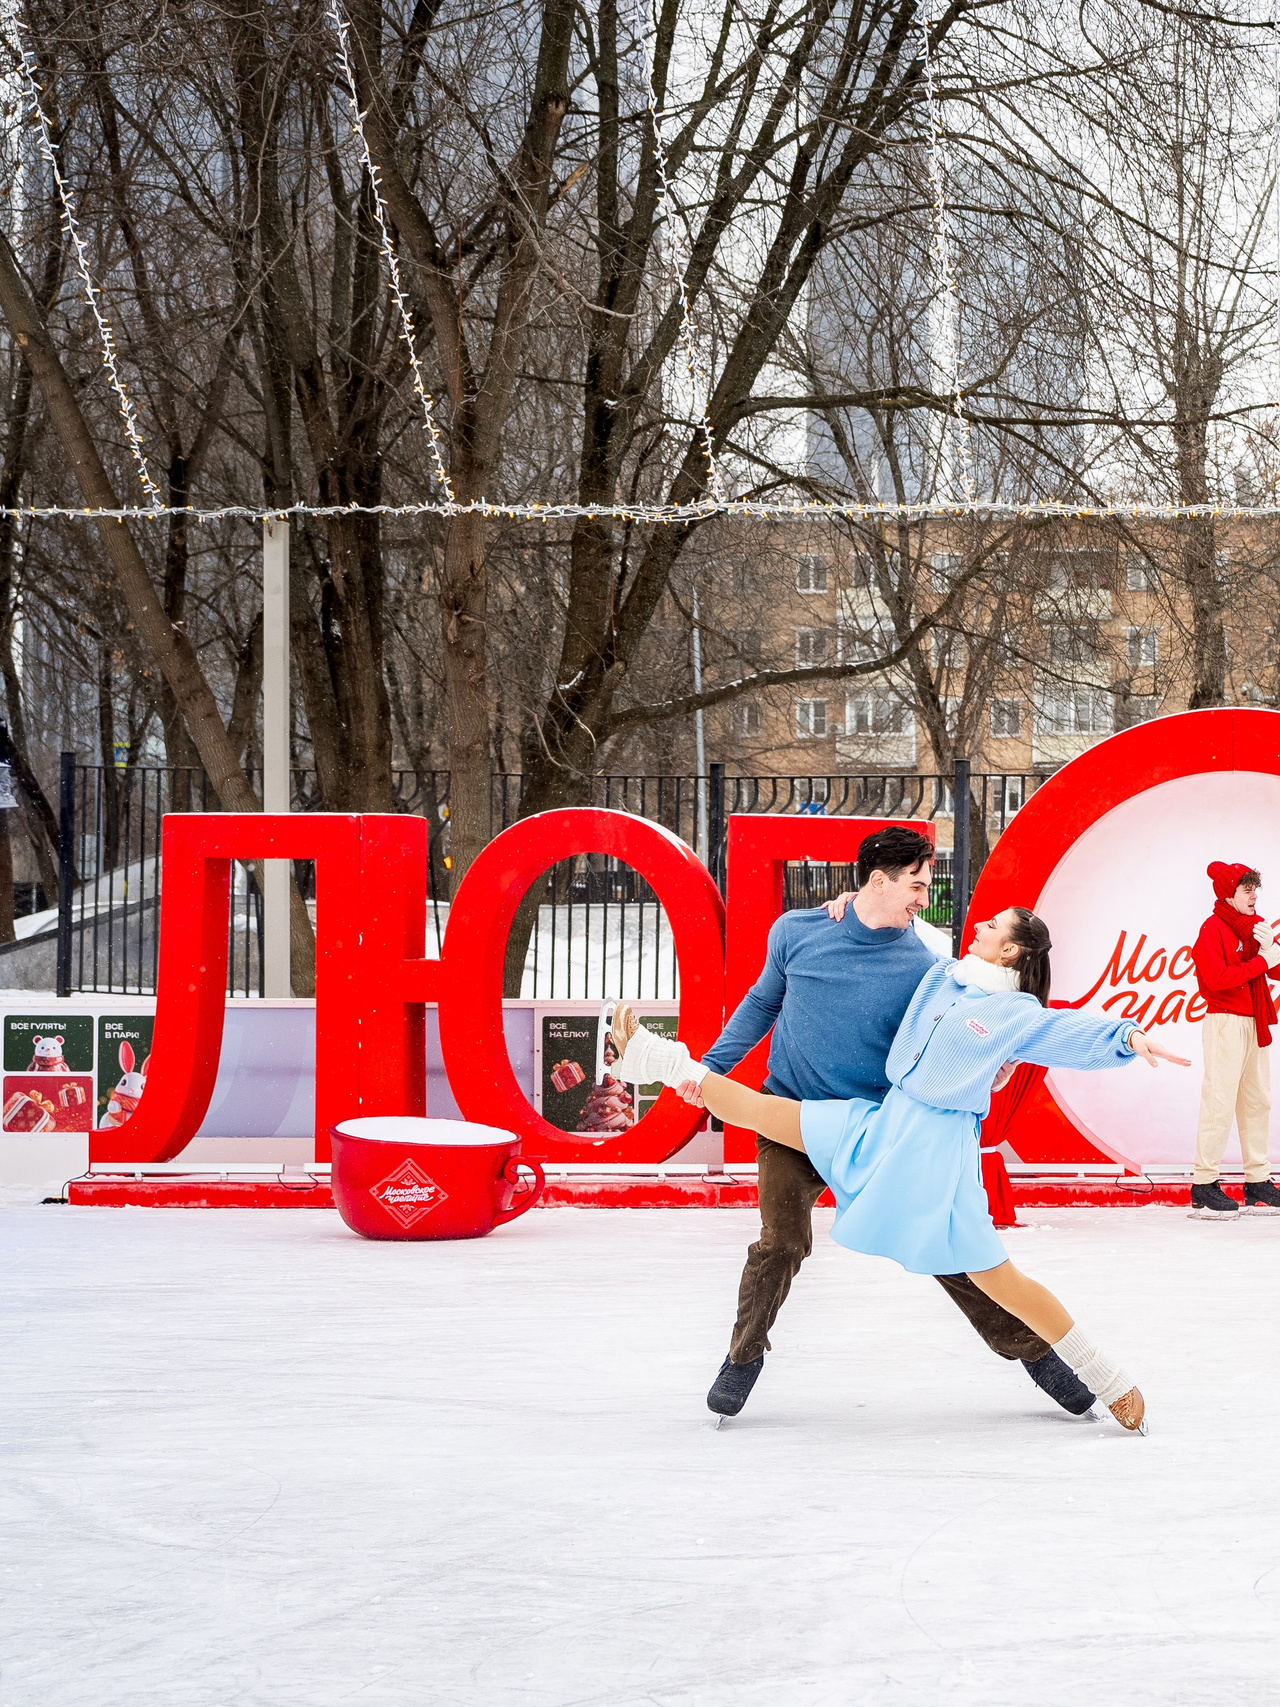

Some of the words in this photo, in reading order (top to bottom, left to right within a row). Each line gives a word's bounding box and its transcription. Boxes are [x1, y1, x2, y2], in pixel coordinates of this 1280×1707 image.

[10, 1022, 29, 1030] ВСЕ
[30, 1022, 67, 1030] ГУЛЯТЬ!
[104, 1023, 123, 1031] ВСЕ
[549, 1022, 568, 1030] ВСЕ
[646, 1022, 664, 1030] ВСЕ
[104, 1031, 111, 1039] В
[112, 1031, 140, 1039] ПАРК!
